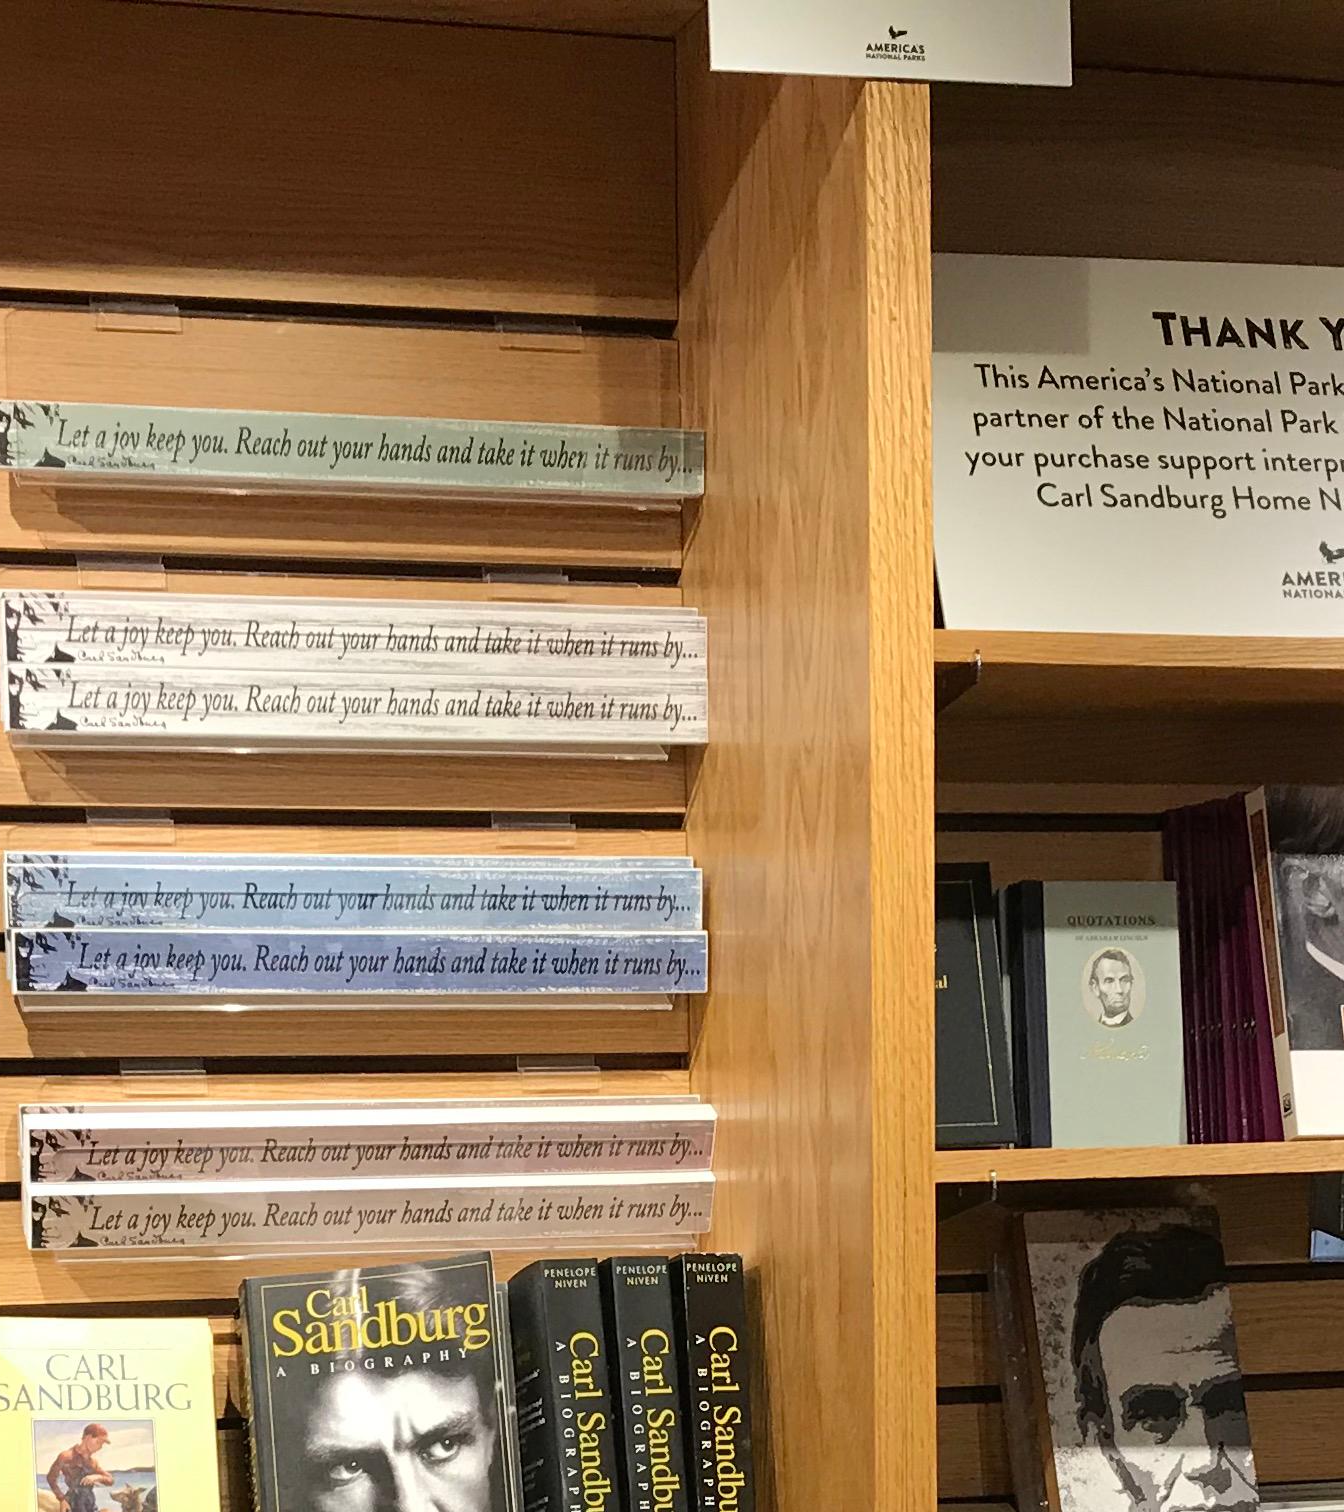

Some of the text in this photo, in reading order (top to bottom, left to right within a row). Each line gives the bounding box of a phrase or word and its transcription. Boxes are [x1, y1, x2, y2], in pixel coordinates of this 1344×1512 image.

[1152, 311, 1310, 351] THANK
[974, 363, 1030, 390] This
[1037, 366, 1165, 393] America's
[1173, 368, 1282, 396] National
[973, 408, 1069, 435] partner
[1078, 404, 1103, 429] of
[1112, 406, 1155, 431] the
[1164, 406, 1273, 434] National
[1282, 410, 1338, 435] Park
[965, 450, 1025, 476] your
[1034, 448, 1149, 476] purchase
[1158, 449, 1256, 476] support
[1037, 483, 1093, 509] Carl
[1100, 485, 1227, 518] Sandburg
[1233, 488, 1311, 512] Home
[70, 681, 101, 710] Let
[107, 690, 117, 710] a
[121, 683, 151, 720] joy
[156, 682, 196, 721] keep
[202, 690, 238, 723] you.
[245, 685, 301, 713] Reach
[306, 690, 336, 714] out
[340, 693, 381, 724] your
[386, 686, 439, 716] hands
[446, 689, 479, 717] and
[484, 690, 522, 718] take
[527, 693, 541, 718] it
[548, 690, 594, 720] when
[601, 693, 616, 721] it
[620, 700, 658, 722] runs
[1067, 915, 1156, 928] QUOTATIONS
[686, 1262, 737, 1272] PENELOPE
[696, 1274, 728, 1283] NIVEN
[307, 1284, 369, 1319] Carl
[273, 1302, 490, 1358] Sandburg
[46, 1354, 138, 1381] CARL
[709, 1326, 740, 1393] Carl
